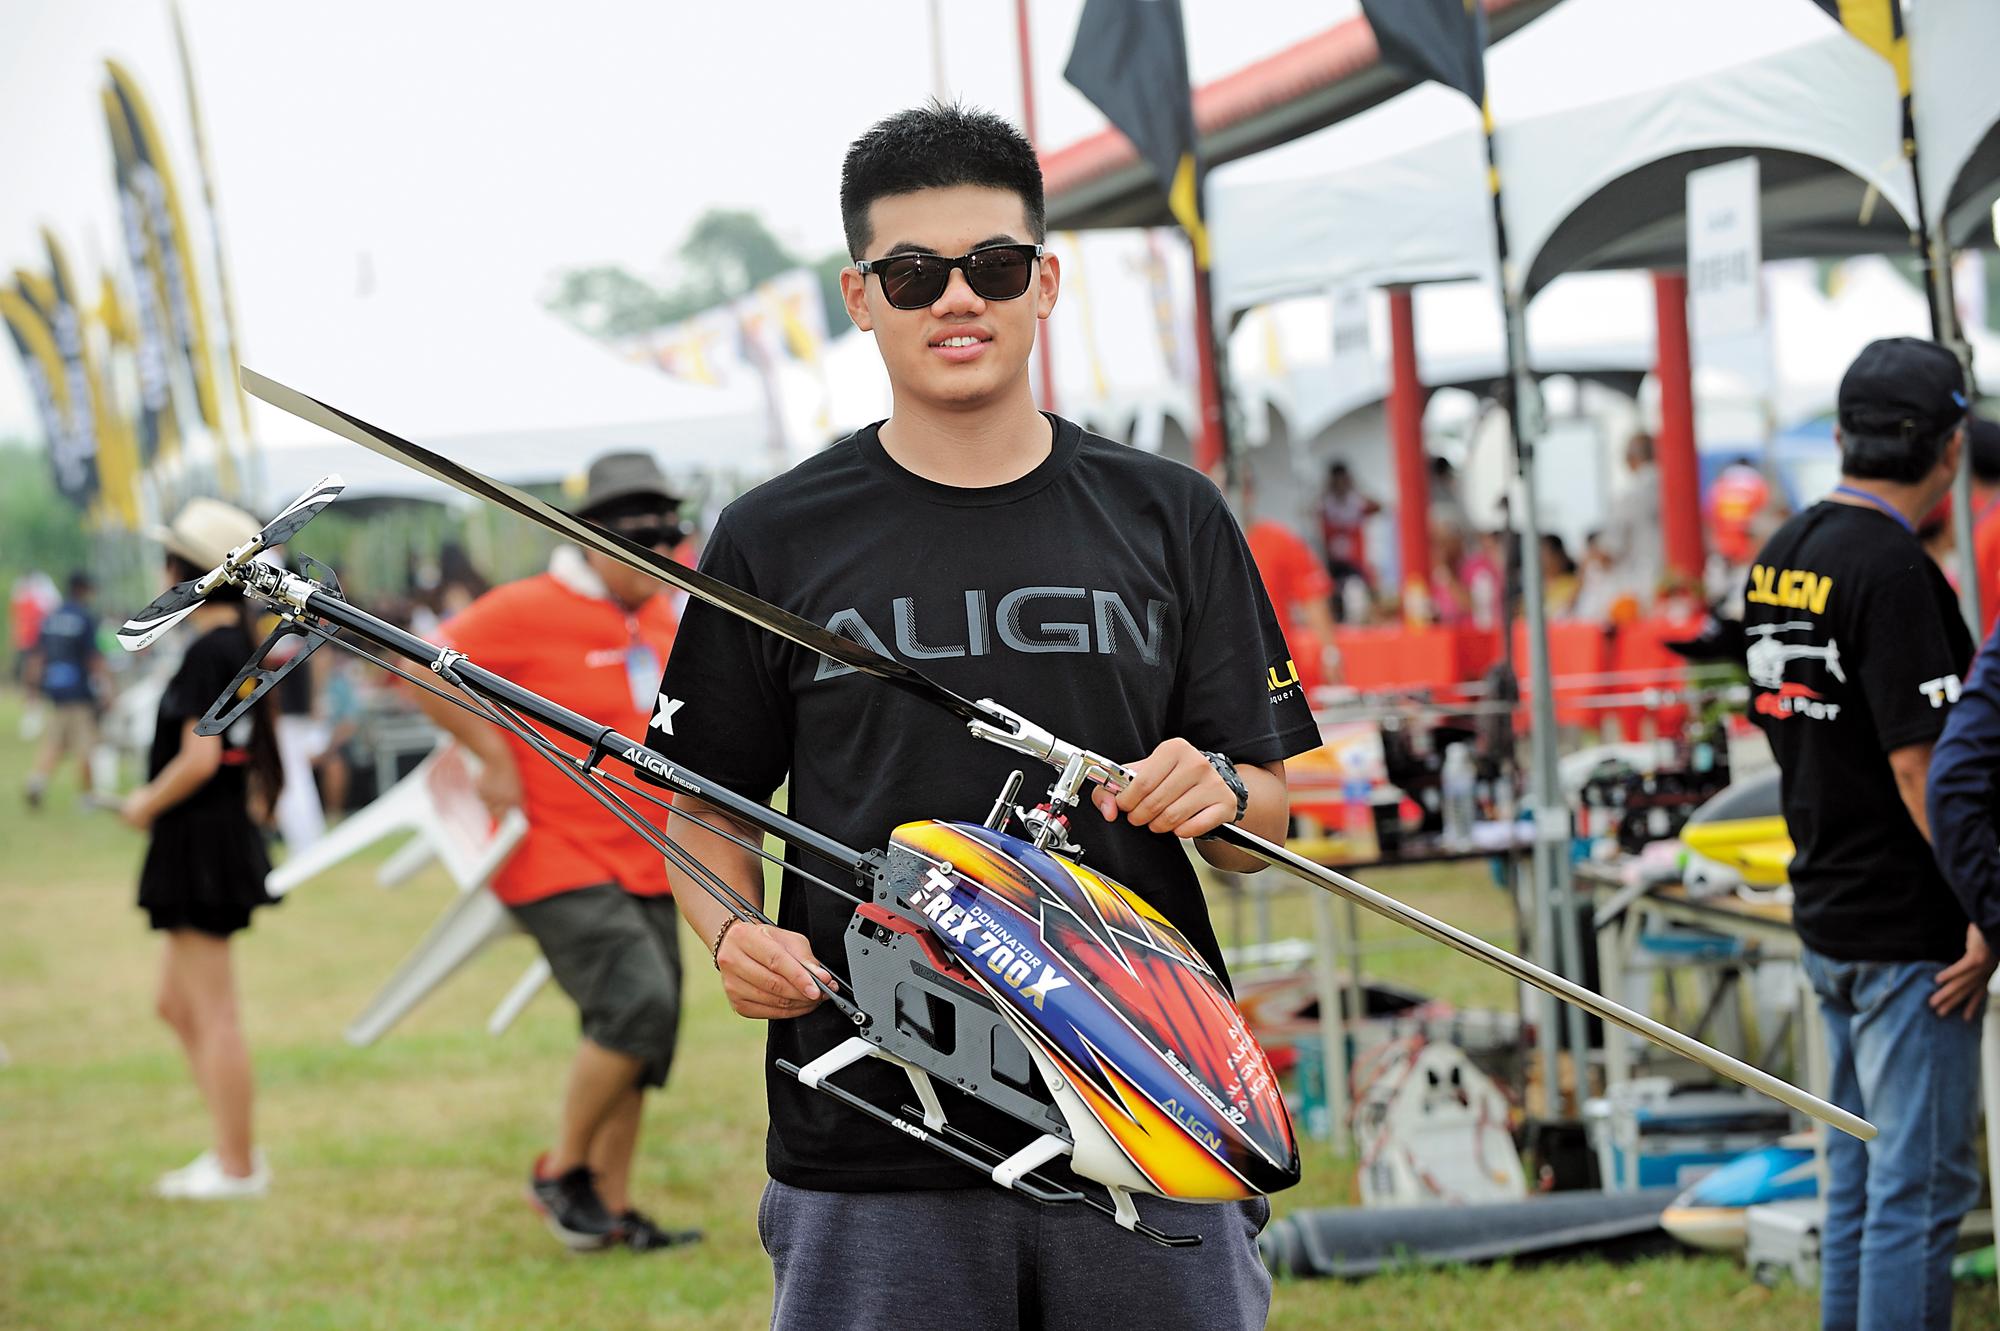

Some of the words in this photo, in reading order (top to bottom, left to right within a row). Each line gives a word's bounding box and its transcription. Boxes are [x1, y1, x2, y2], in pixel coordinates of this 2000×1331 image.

[814, 587, 1169, 681] ALIGN
[622, 748, 674, 780] ALIGN
[909, 867, 982, 944] T-REX
[970, 906, 1042, 968] DOMINATOR
[891, 1118, 929, 1142] ALIGN
[1160, 1098, 1223, 1151] ALIGN
[1223, 1105, 1247, 1125] 3D
